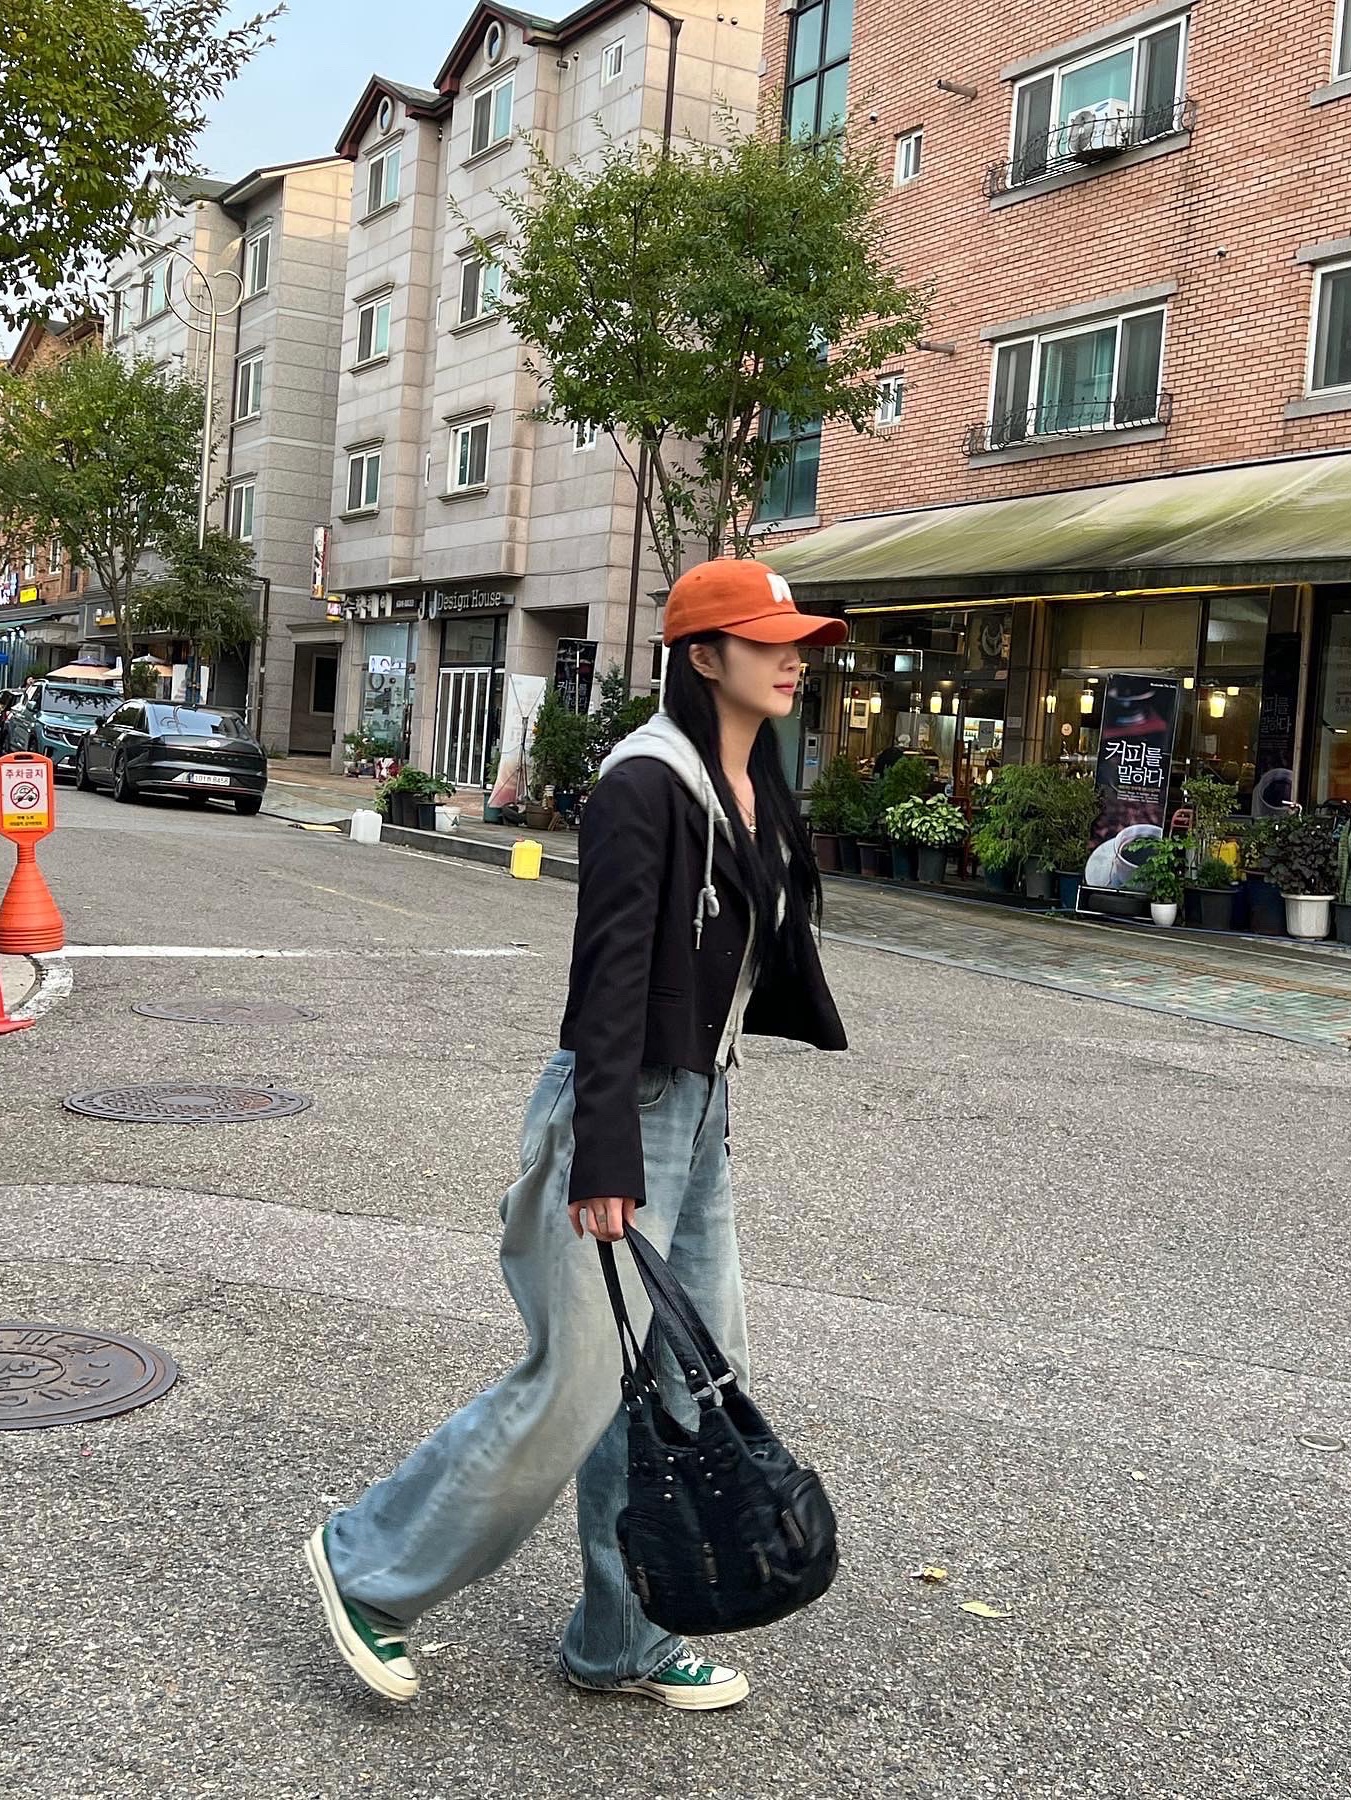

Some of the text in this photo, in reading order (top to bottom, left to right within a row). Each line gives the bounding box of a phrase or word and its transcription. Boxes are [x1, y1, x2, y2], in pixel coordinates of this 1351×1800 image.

[438, 592, 470, 612] Design
[471, 589, 501, 607] House
[1105, 740, 1163, 767] 커피를
[5, 768, 43, 779] 주차금지
[1118, 765, 1165, 788] 말하다
